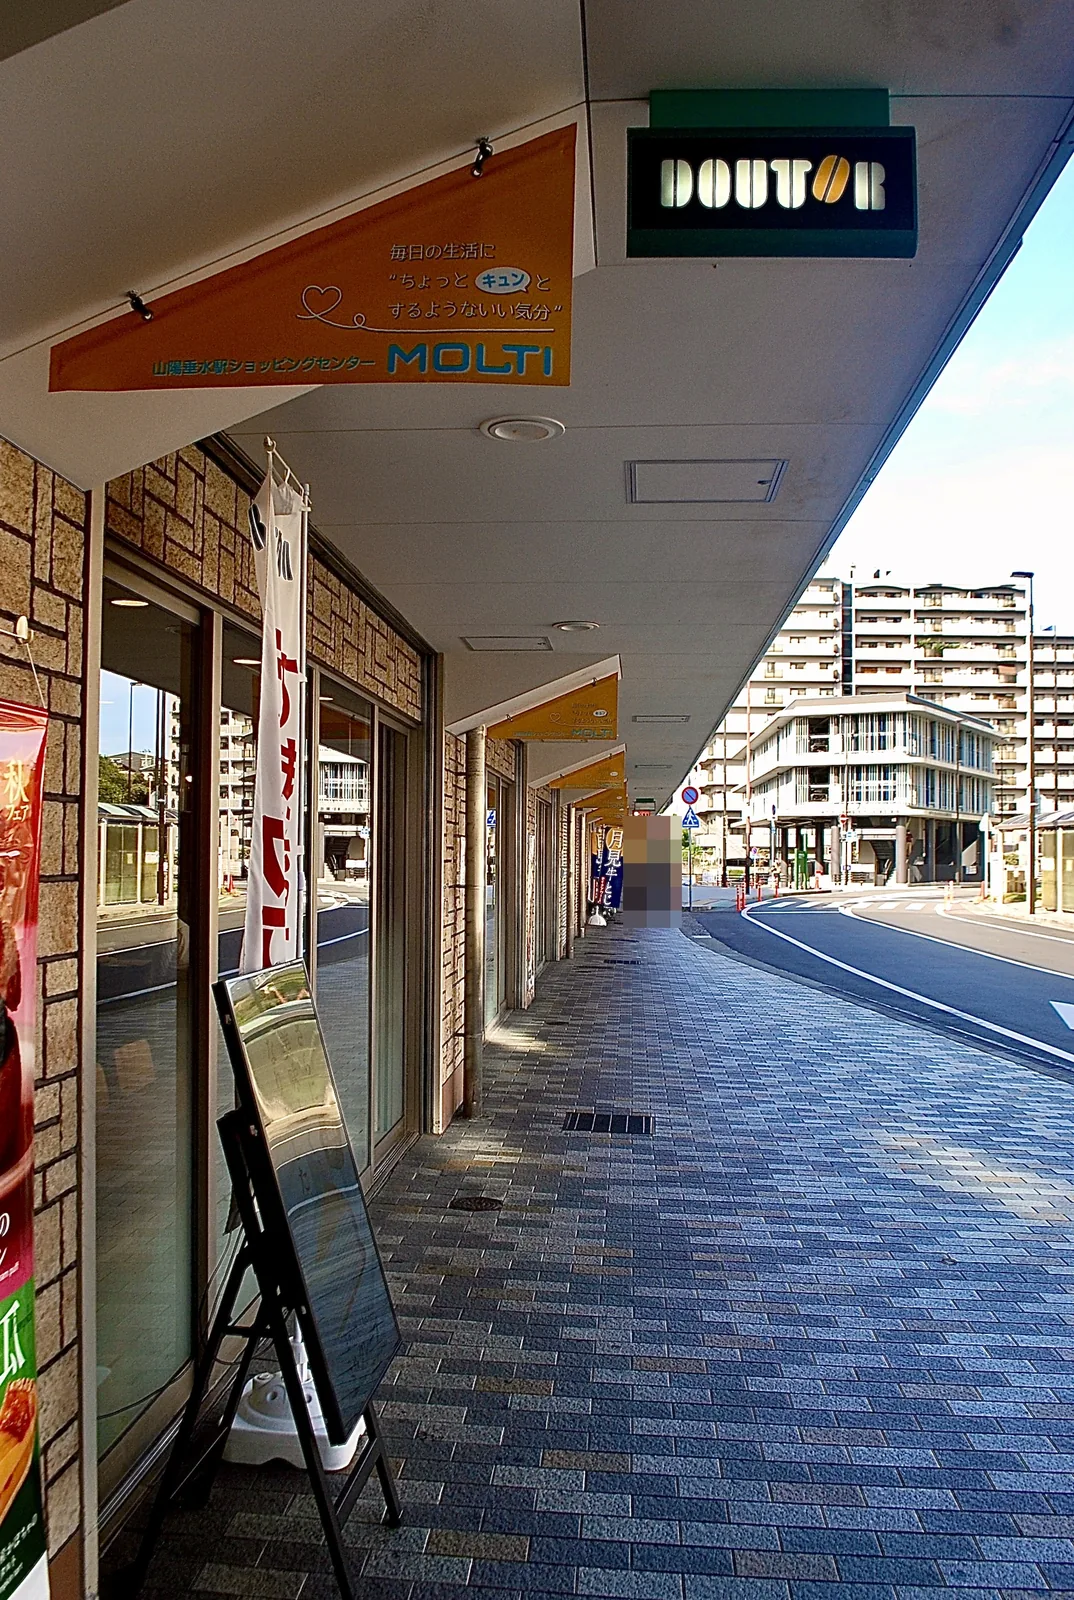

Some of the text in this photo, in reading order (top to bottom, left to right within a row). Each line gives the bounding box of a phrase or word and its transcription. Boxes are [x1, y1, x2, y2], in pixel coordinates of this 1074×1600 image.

[660, 154, 886, 211] DOUTOR
[390, 243, 495, 261] 毎日の生活に
[482, 273, 525, 288] キュン
[536, 274, 550, 291] と
[152, 356, 376, 377] 山陽垂水駅ショッピングセンター
[387, 343, 553, 377] MOLTI
[4, 760, 30, 804] 秋
[5, 804, 30, 822] フェア
